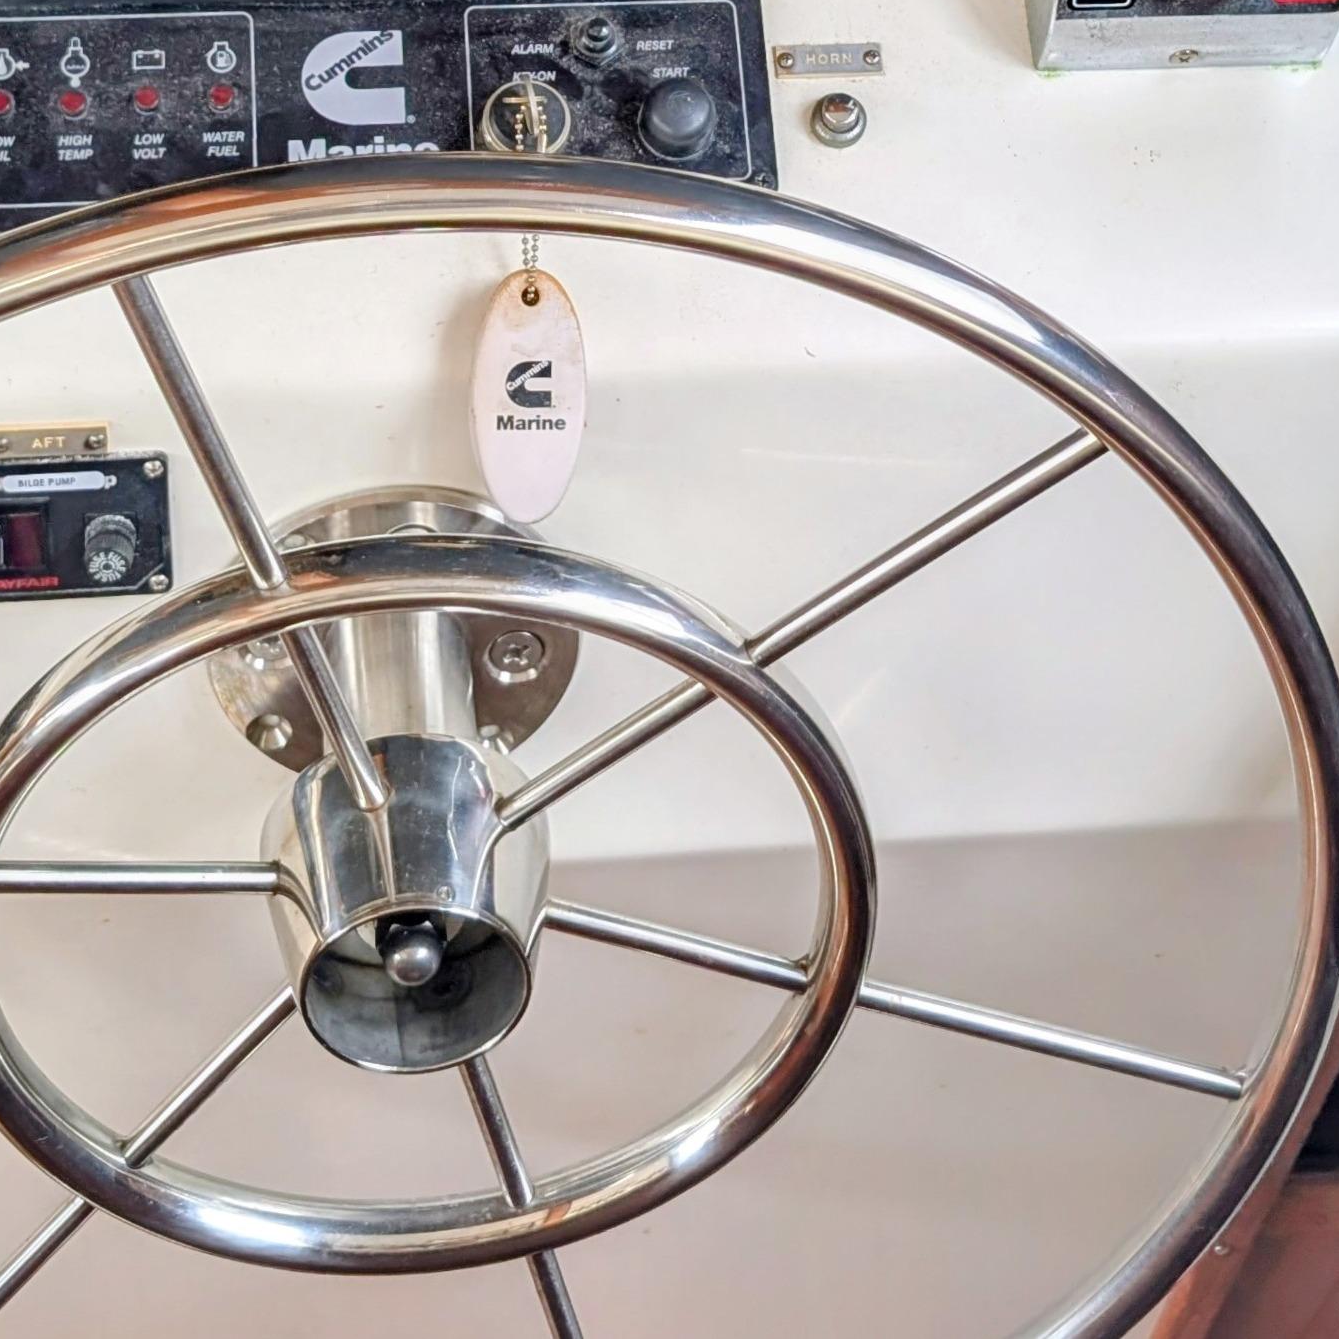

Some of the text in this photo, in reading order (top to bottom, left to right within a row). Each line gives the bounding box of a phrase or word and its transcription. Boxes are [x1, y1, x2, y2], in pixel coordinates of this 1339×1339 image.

[511, 43, 555, 55] ALARM
[636, 40, 675, 52] RESET
[304, 30, 394, 91] Cummins
[805, 52, 853, 66] HORN
[652, 66, 690, 79] START
[58, 134, 93, 147] HIGH
[134, 133, 165, 146] LOW
[202, 131, 245, 144] WATER
[57, 148, 94, 161] TEMP
[132, 147, 167, 160] VOLT
[206, 144, 241, 157] FUEL
[496, 415, 566, 430] Marine
[32, 436, 66, 449] AFT
[18, 477, 76, 488] BILGE PUMP
